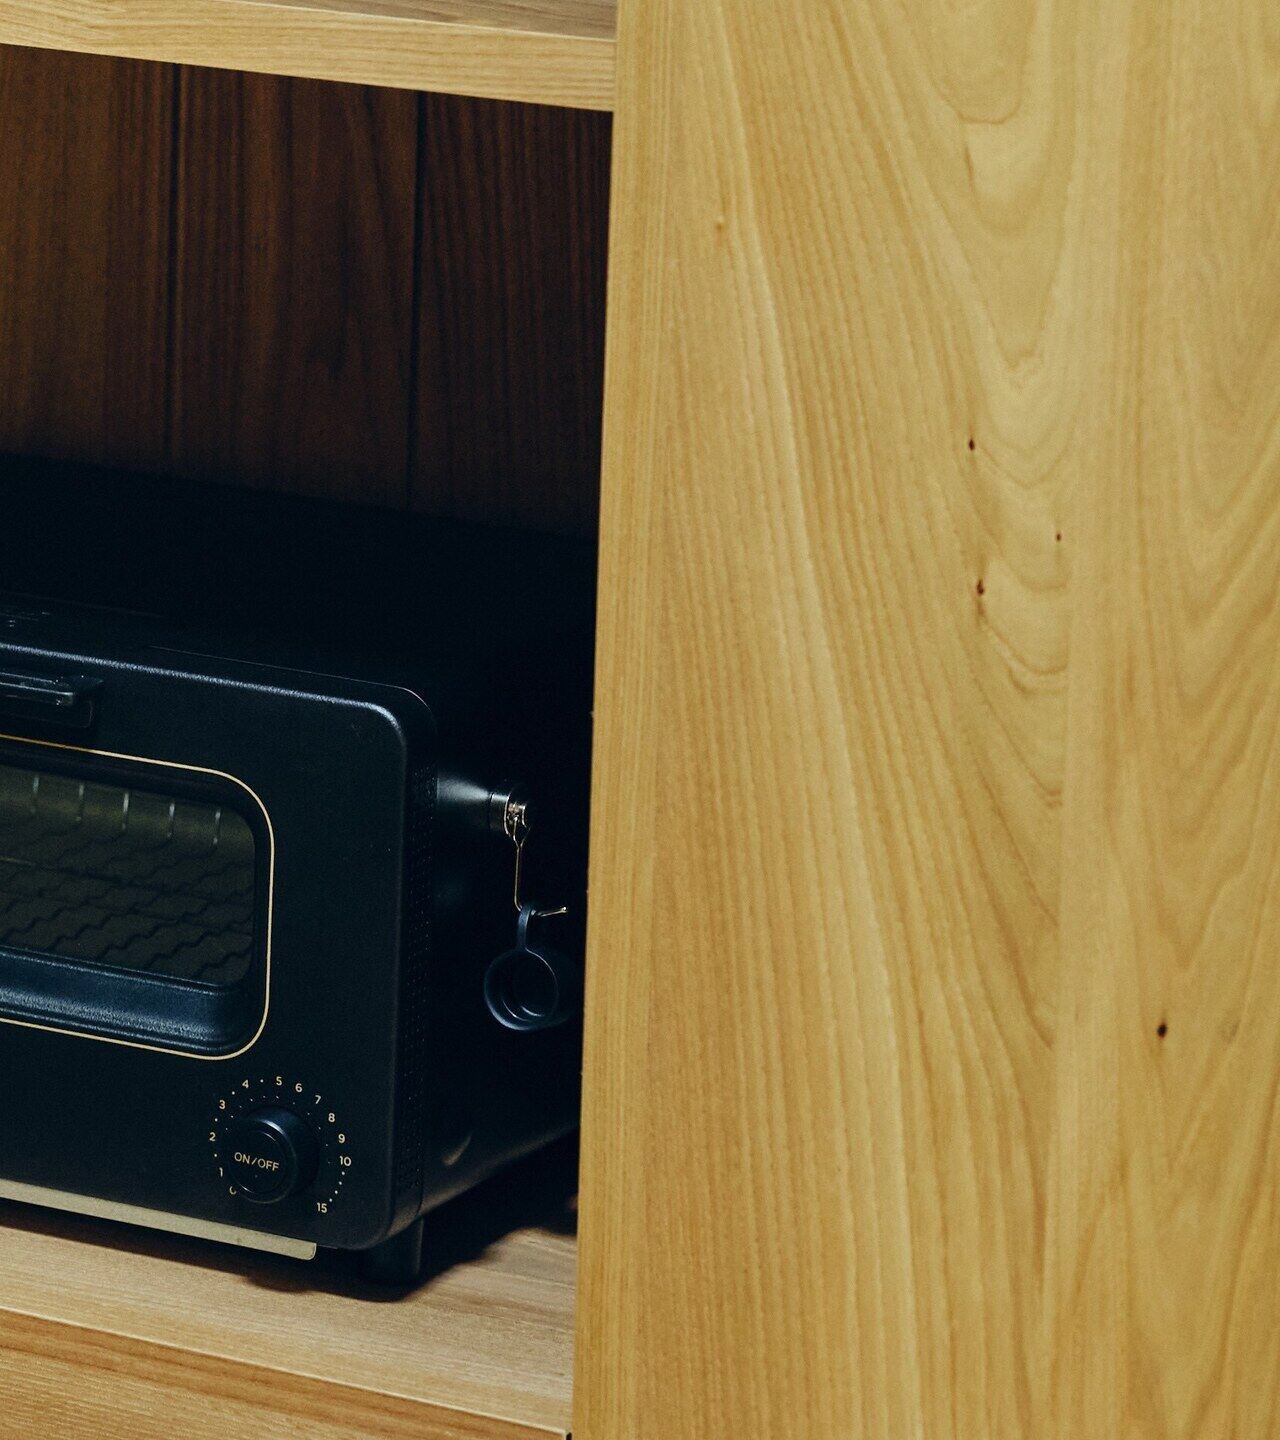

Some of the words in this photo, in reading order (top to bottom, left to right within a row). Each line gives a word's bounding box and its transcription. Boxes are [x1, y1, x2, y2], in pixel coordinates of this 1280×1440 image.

[241, 1079, 250, 1089] 4
[275, 1076, 283, 1087] 5
[294, 1082, 303, 1093] 6
[218, 1099, 226, 1110] 3
[314, 1095, 322, 1105] 7
[327, 1112, 336, 1123] 8
[209, 1131, 217, 1142] 2
[338, 1133, 346, 1144] 9
[233, 1151, 280, 1172] ON/OFF
[339, 1155, 352, 1167] 10
[218, 1167, 224, 1177] 1
[316, 1202, 328, 1214] 15
